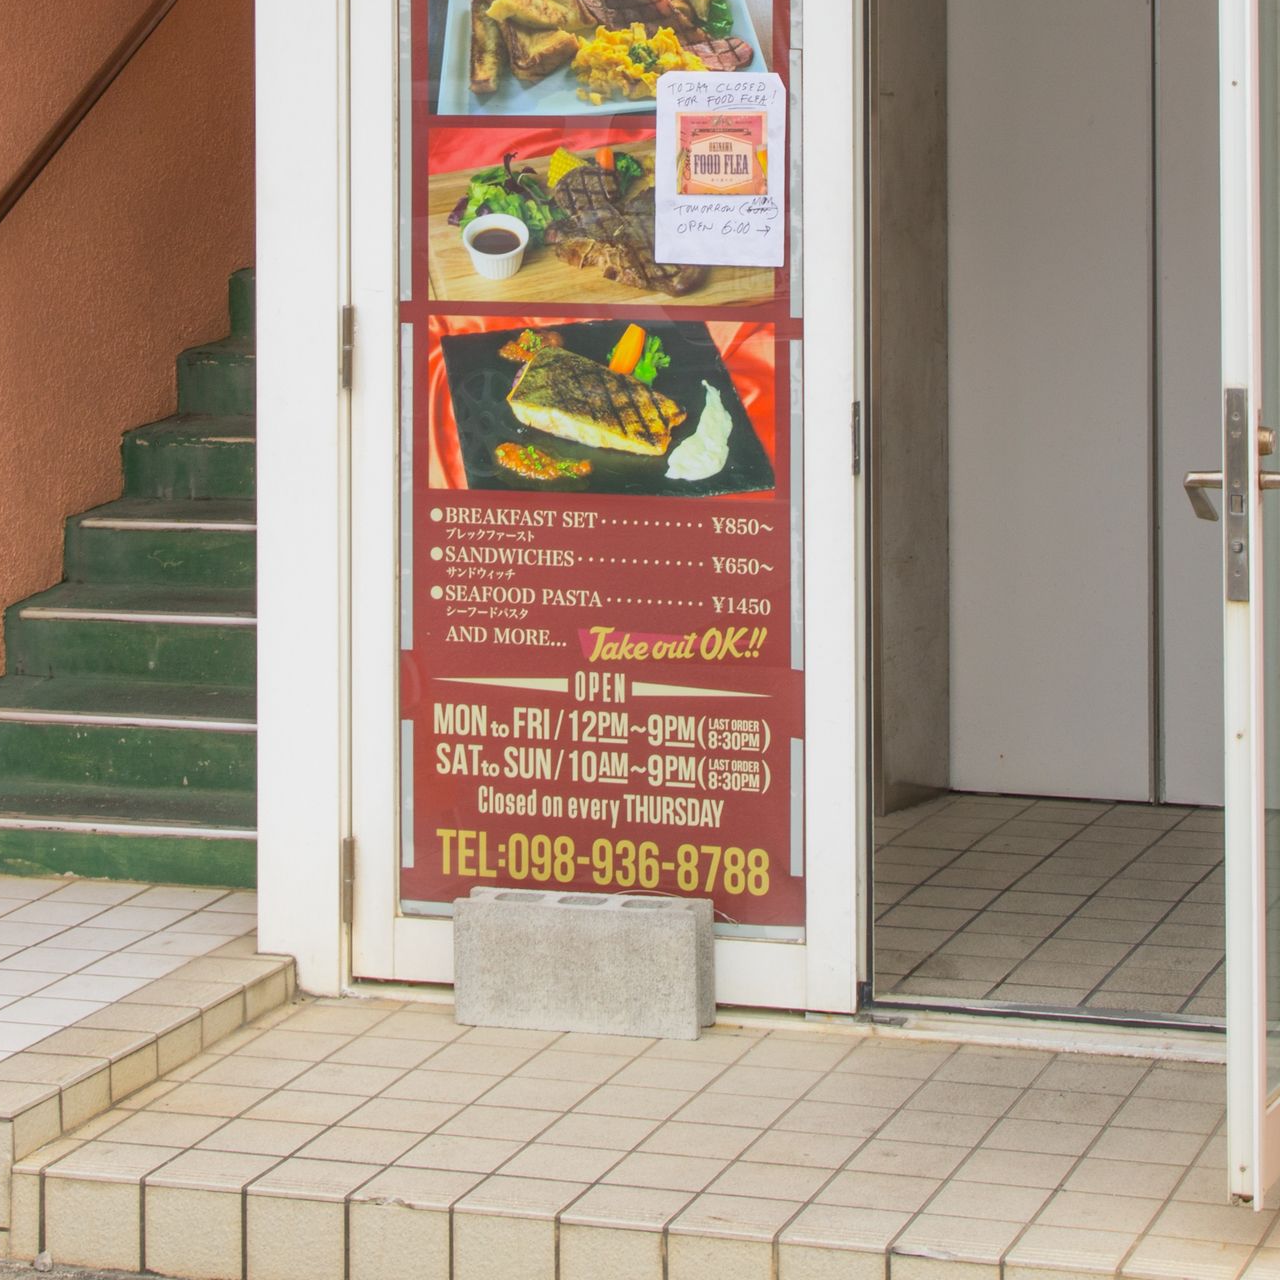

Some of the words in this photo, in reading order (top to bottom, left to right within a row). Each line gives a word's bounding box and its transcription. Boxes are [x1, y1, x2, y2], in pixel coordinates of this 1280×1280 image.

[716, 81, 766, 92] CLOSED
[677, 96, 698, 106] FOR
[707, 94, 734, 107] FOOD
[694, 154, 720, 175] FOOD
[724, 154, 749, 175] FLEA
[677, 220, 713, 234] OPEN
[445, 507, 557, 527] BREAKFAST
[562, 511, 598, 529] SET
[446, 528, 535, 542] ブレックファースト
[445, 546, 575, 567] SANDWICHES
[446, 566, 515, 580] サンドウィッチ
[445, 585, 536, 604] SEAFOOD
[542, 589, 603, 608] PASTA
[712, 596, 771, 616] ¥1450
[446, 606, 529, 619] シーフードパスタ
[445, 625, 487, 643] AND
[588, 625, 649, 663] Take
[652, 632, 698, 659] out
[700, 626, 768, 661] OK!!
[575, 671, 625, 704] OPEN
[433, 703, 487, 737] MON
[490, 721, 510, 738] to
[513, 707, 550, 740] FRI
[708, 718, 730, 730] LAST
[731, 719, 759, 732] ORDER
[708, 731, 760, 752] 8:30PM
[436, 742, 483, 776] SAT
[481, 760, 500, 777] to
[504, 746, 552, 780] SUN
[708, 758, 730, 770] LAST
[731, 760, 759, 773] ORDER
[708, 772, 760, 793] 8:30PM
[478, 785, 537, 816] Closed
[542, 795, 563, 818] on
[568, 796, 620, 829] every
[623, 794, 725, 828] THURSDAY
